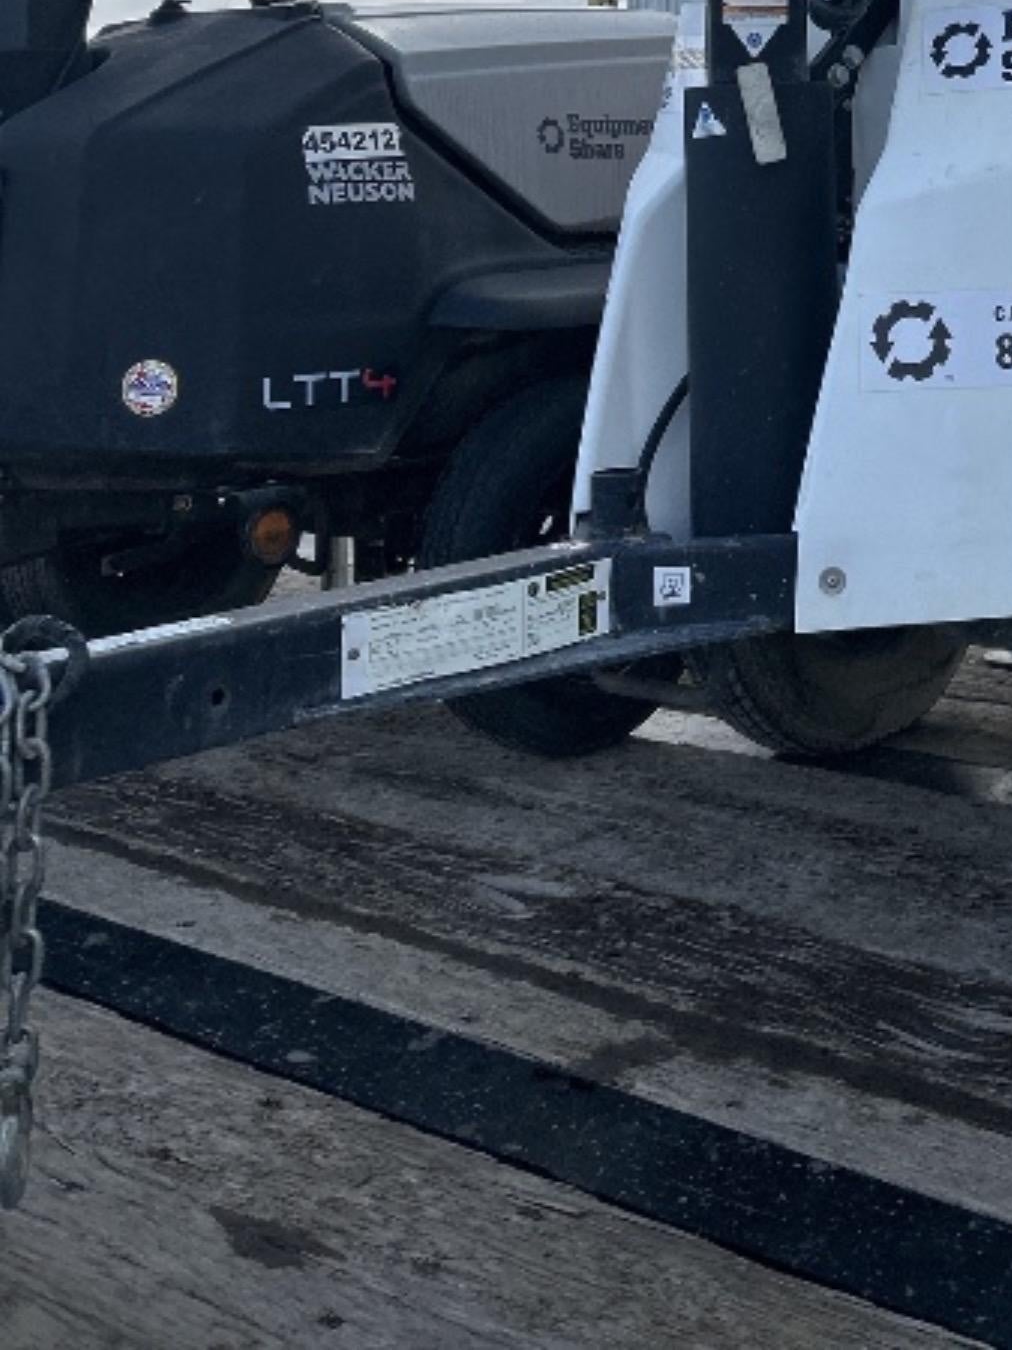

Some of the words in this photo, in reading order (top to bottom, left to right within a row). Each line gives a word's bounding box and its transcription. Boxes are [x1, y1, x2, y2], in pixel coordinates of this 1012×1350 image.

[303, 128, 397, 153] 454212
[306, 160, 414, 184] WACKER
[308, 182, 415, 205] NEUSON
[262, 367, 397, 411] LTT4
